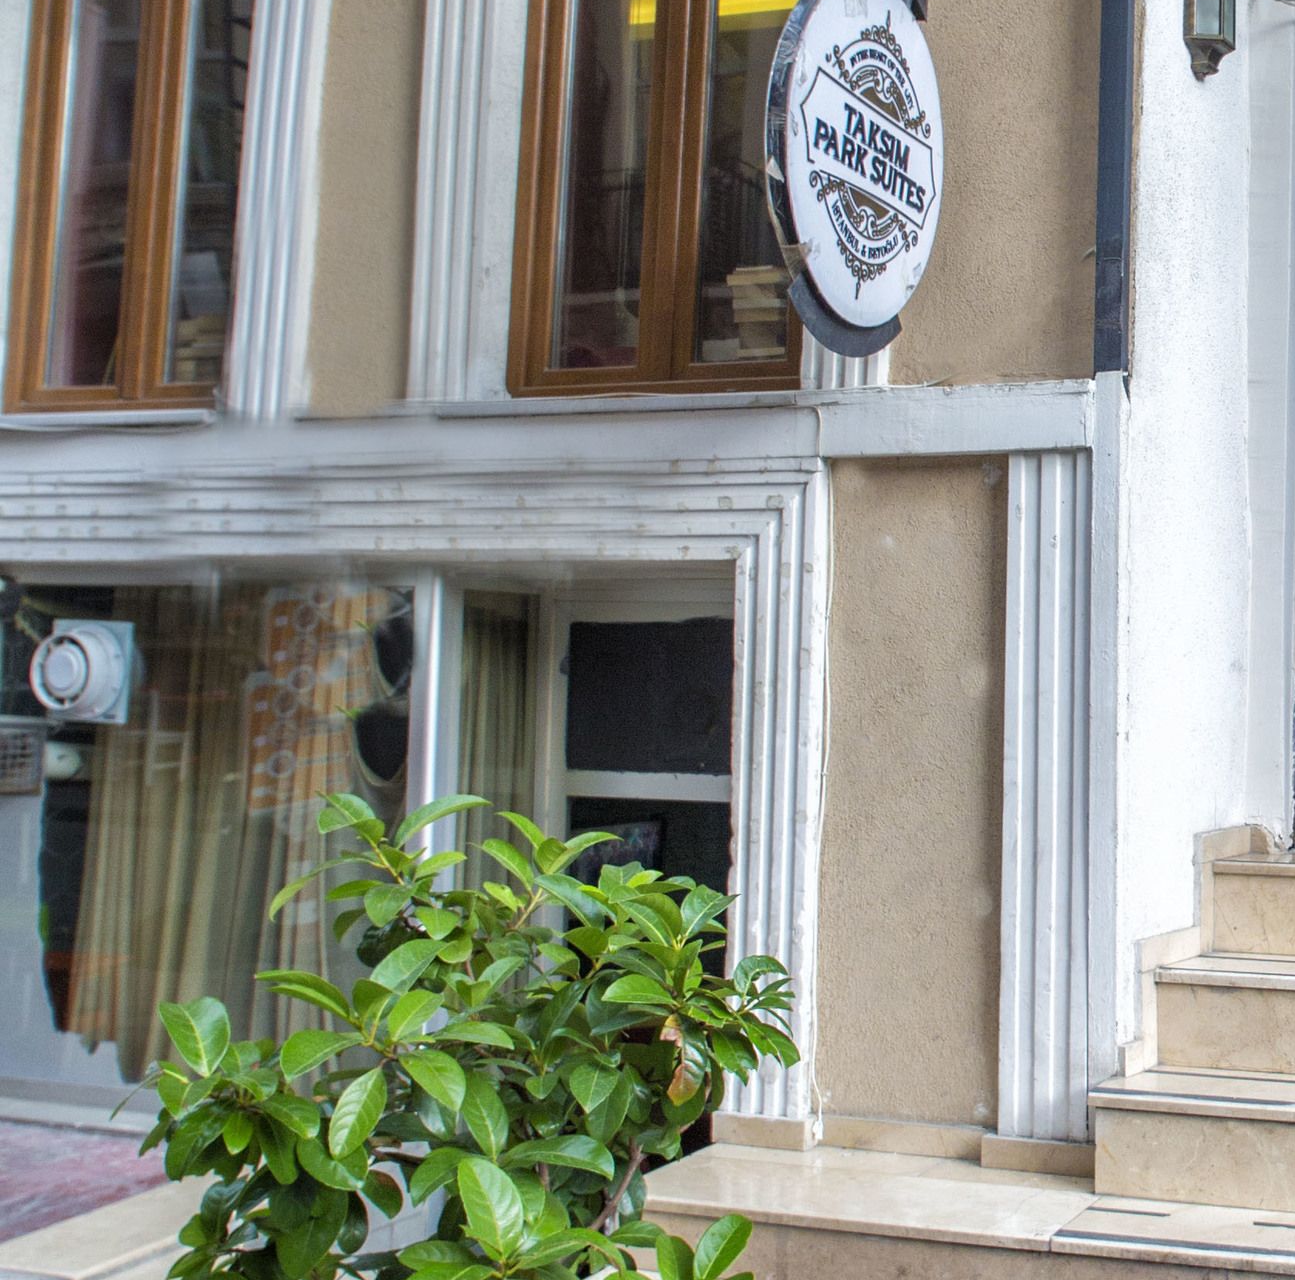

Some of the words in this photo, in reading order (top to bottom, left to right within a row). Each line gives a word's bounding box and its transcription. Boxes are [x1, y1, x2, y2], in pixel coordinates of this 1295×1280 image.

[856, 49, 869, 62] THE
[869, 49, 887, 65] HEART
[888, 58, 896, 71] OF
[814, 117, 868, 178] PARK
[869, 155, 926, 213] SUITES
[844, 102, 910, 173] TAKSIM
